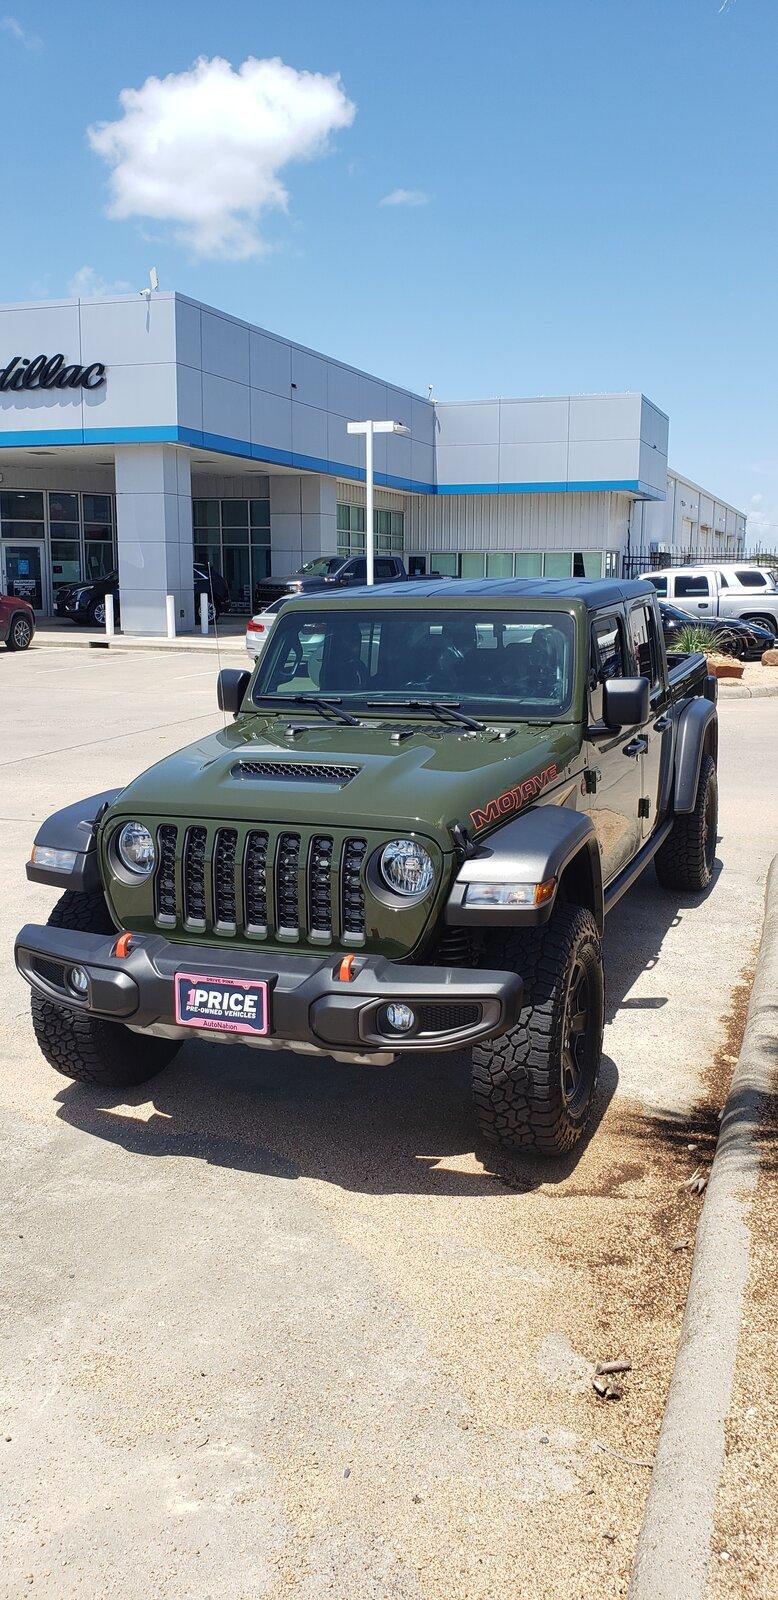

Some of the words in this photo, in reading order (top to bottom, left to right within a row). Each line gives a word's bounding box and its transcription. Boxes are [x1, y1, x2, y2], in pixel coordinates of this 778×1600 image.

[470, 764, 559, 829] MOJAVE
[187, 988, 258, 1012] 1PRICE
[186, 1005, 222, 1016] PRE-OWNED
[224, 1010, 256, 1019] VEHICLES
[203, 1020, 238, 1031] AutoNation
